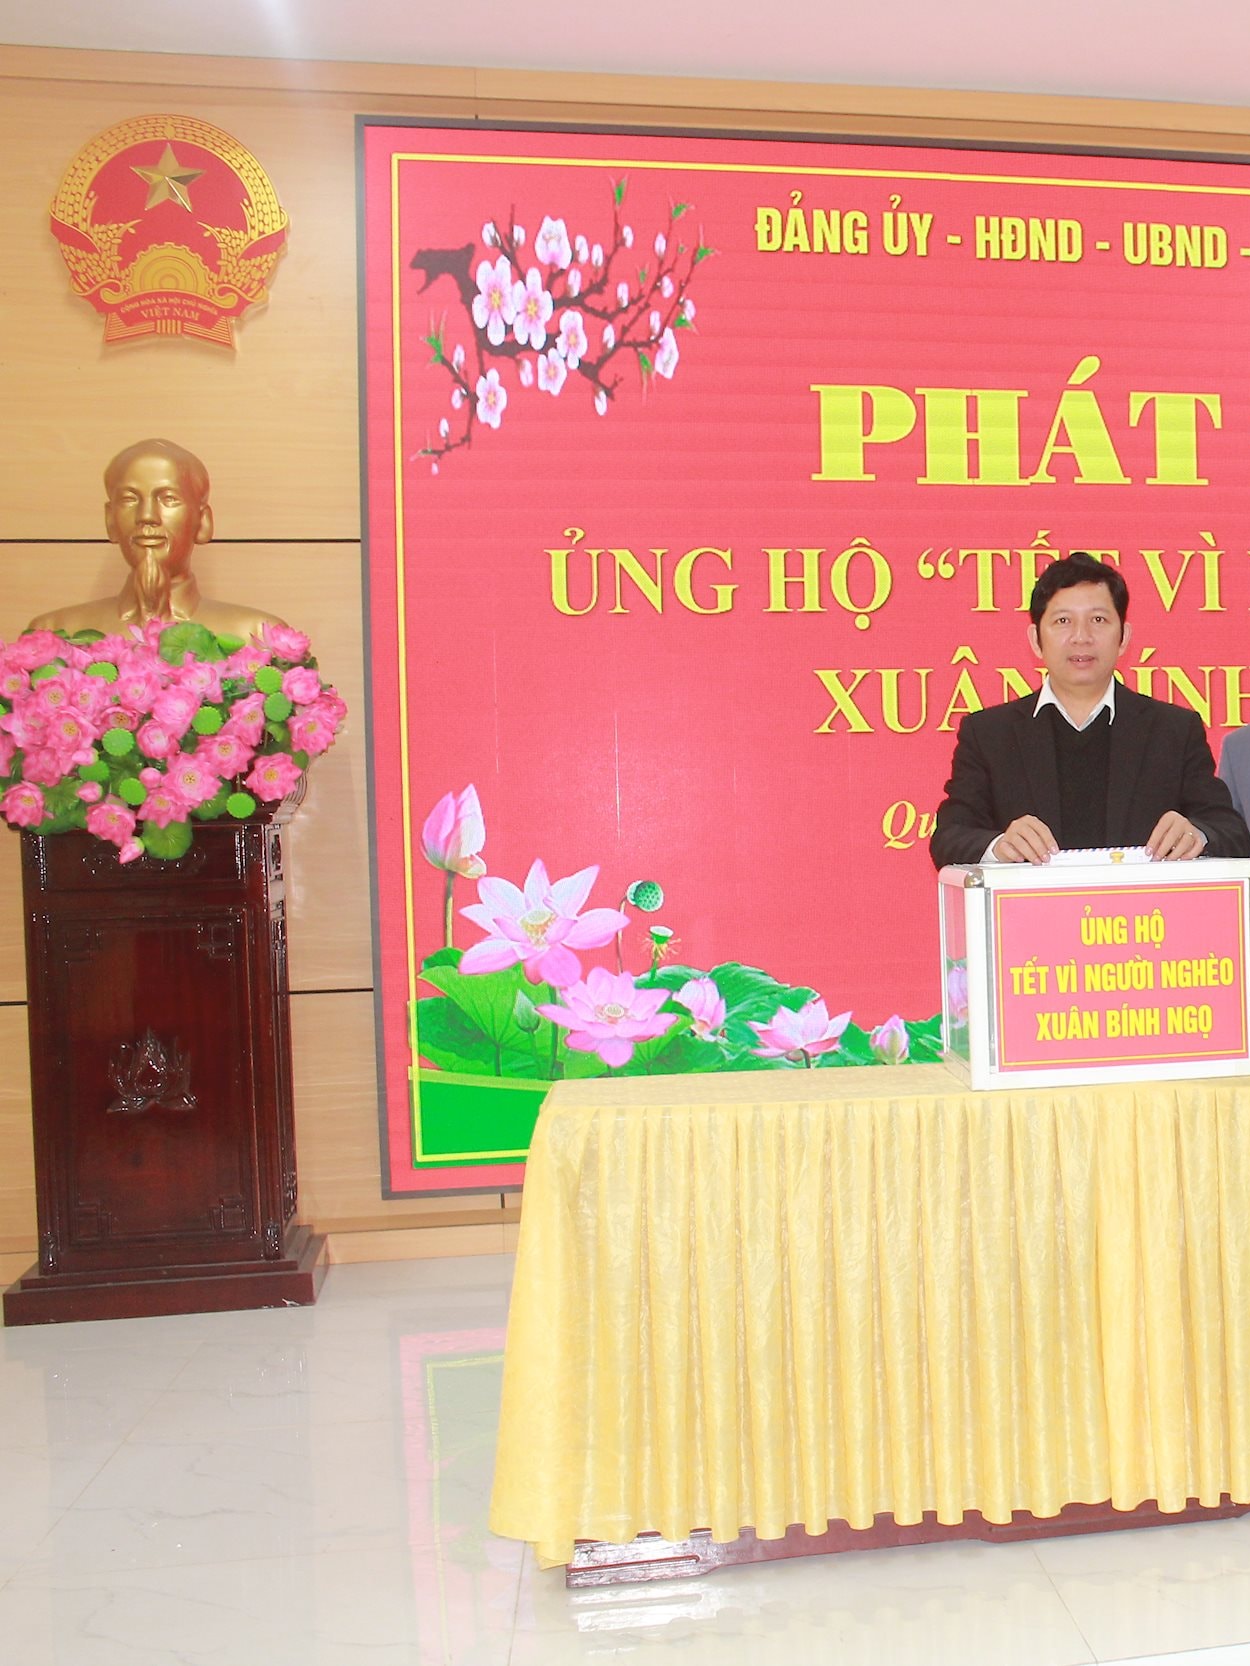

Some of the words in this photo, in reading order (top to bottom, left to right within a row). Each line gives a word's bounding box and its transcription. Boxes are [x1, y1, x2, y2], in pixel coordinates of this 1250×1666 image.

[755, 190, 869, 255] ĐẢNG
[882, 194, 934, 257] ỦY
[946, 235, 962, 246] -
[975, 215, 1083, 264] HĐND
[1095, 240, 1110, 250] -
[1123, 221, 1228, 269] UBND
[140, 304, 170, 319] VIỆT
[172, 306, 200, 321] NAM
[810, 355, 1222, 486] PHÁT
[543, 527, 739, 616] ỦNG
[761, 537, 893, 631] HỘ
[917, 529, 1120, 612] “TẾ
[1139, 531, 1226, 613] VÌ
[882, 800, 938, 850] Qu
[1080, 904, 1128, 946] ỦNG
[1134, 908, 1166, 949] HỘ
[1009, 955, 1050, 996] TẾT
[1055, 958, 1078, 994] VÌ
[1084, 954, 1154, 993] NGƯỜI
[1160, 952, 1235, 990] NGHÈO
[1035, 1005, 1100, 1041] XUÂN
[1106, 1002, 1161, 1038] BÍNH
[1167, 1003, 1213, 1039] NGỌ
